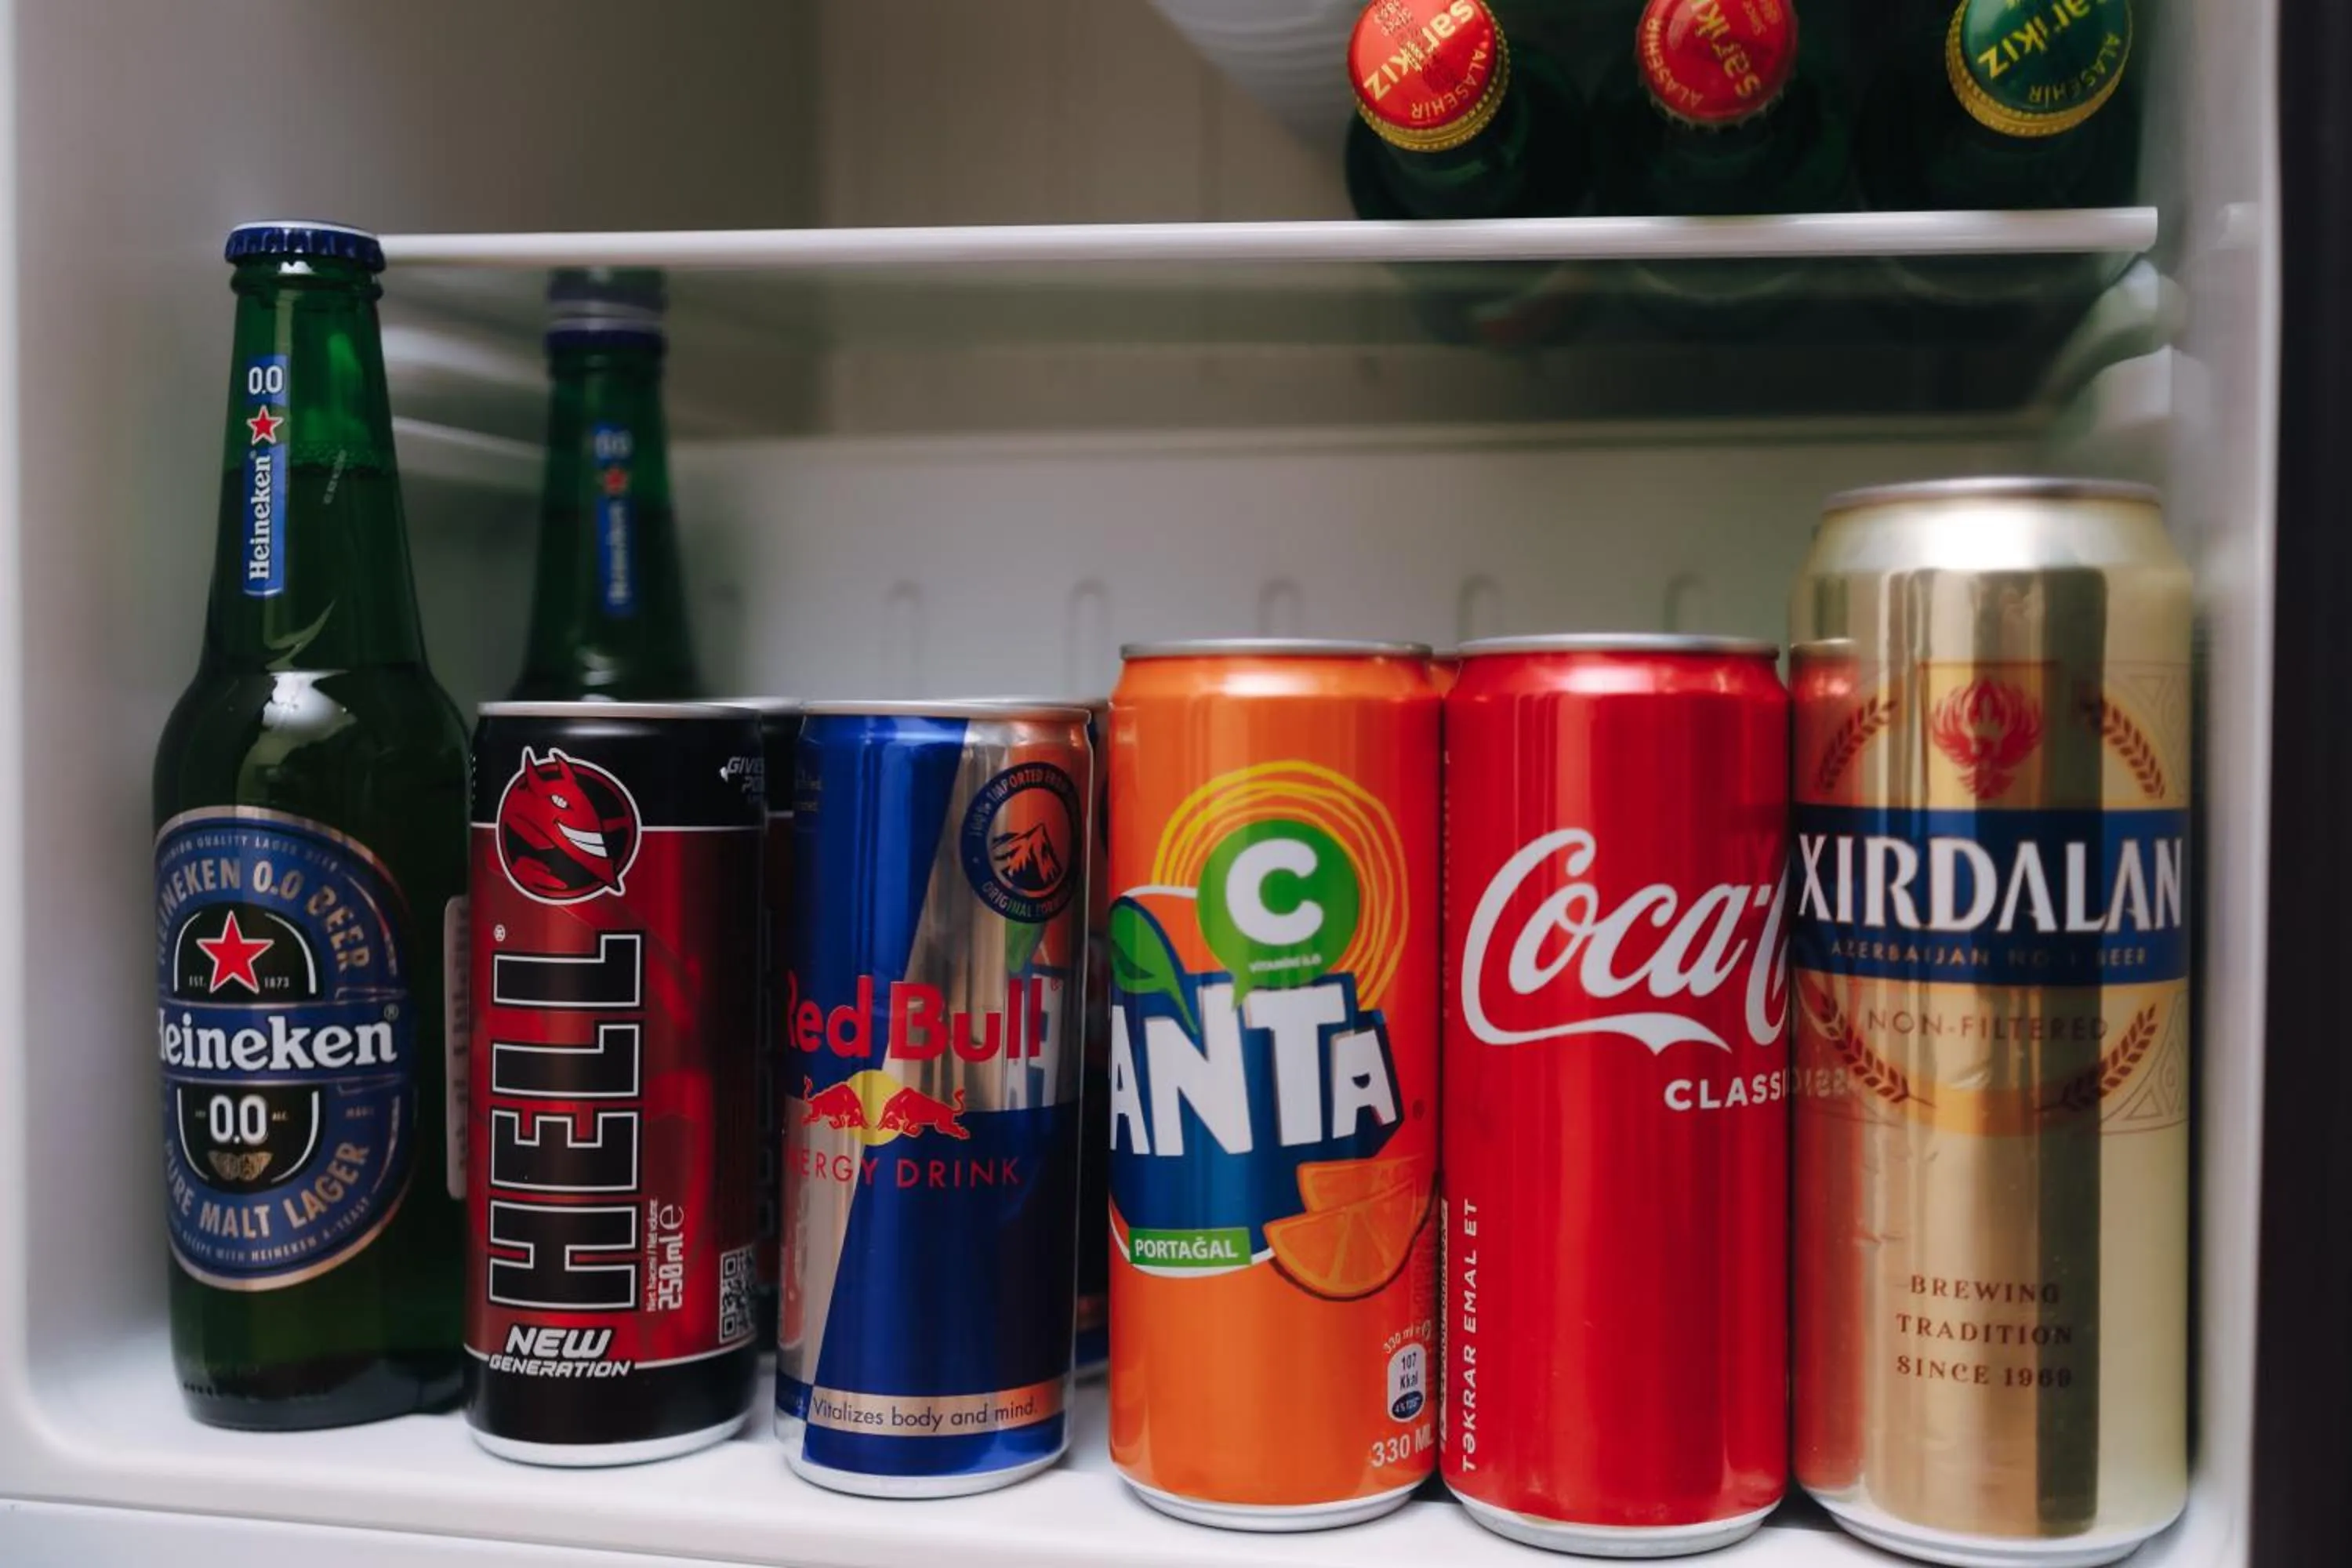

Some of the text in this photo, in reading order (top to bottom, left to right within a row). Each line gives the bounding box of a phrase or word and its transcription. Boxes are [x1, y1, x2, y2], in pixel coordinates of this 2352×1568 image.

[248, 365, 284, 394] 0.0
[249, 453, 271, 579] Heineken
[1225, 837, 1324, 946] C
[1798, 833, 2183, 934] XIRDALAN
[252, 859, 304, 901] 0.0
[306, 884, 370, 973] BEER
[1830, 943, 1990, 967] AZERBAIJAN
[2096, 948, 2147, 966] BEER
[889, 977, 1043, 1063] Bull
[1867, 1009, 2108, 1041] NON-FILTERED
[1109, 981, 1397, 1157] ANTA
[1663, 1069, 1787, 1112] CLASSI
[209, 1094, 267, 1145] 0.0
[488, 932, 642, 1310] HELL
[788, 1146, 1021, 1189] ERGY DRINK
[198, 1200, 271, 1240] MALT
[282, 1142, 370, 1230] LAGER
[1463, 1199, 1477, 1237] ET
[251, 1236, 317, 1264] HEINEKEN
[1134, 1236, 1240, 1260] PORTAĞAL
[658, 1232, 684, 1312] 250ml
[1911, 1274, 2060, 1305] BREWING
[1463, 1250, 1477, 1334] EMAL
[505, 1324, 612, 1359] NEW
[1896, 1312, 2073, 1346] TRADITION
[489, 1354, 632, 1377] GENERATION
[1400, 1352, 1417, 1369] 107
[1896, 1355, 1991, 1385] SINCE
[812, 1396, 884, 1426] Vitalizes
[891, 1404, 944, 1432] body
[950, 1404, 987, 1425] and
[994, 1398, 1039, 1422] mind.
[1371, 1433, 1410, 1468] 330
